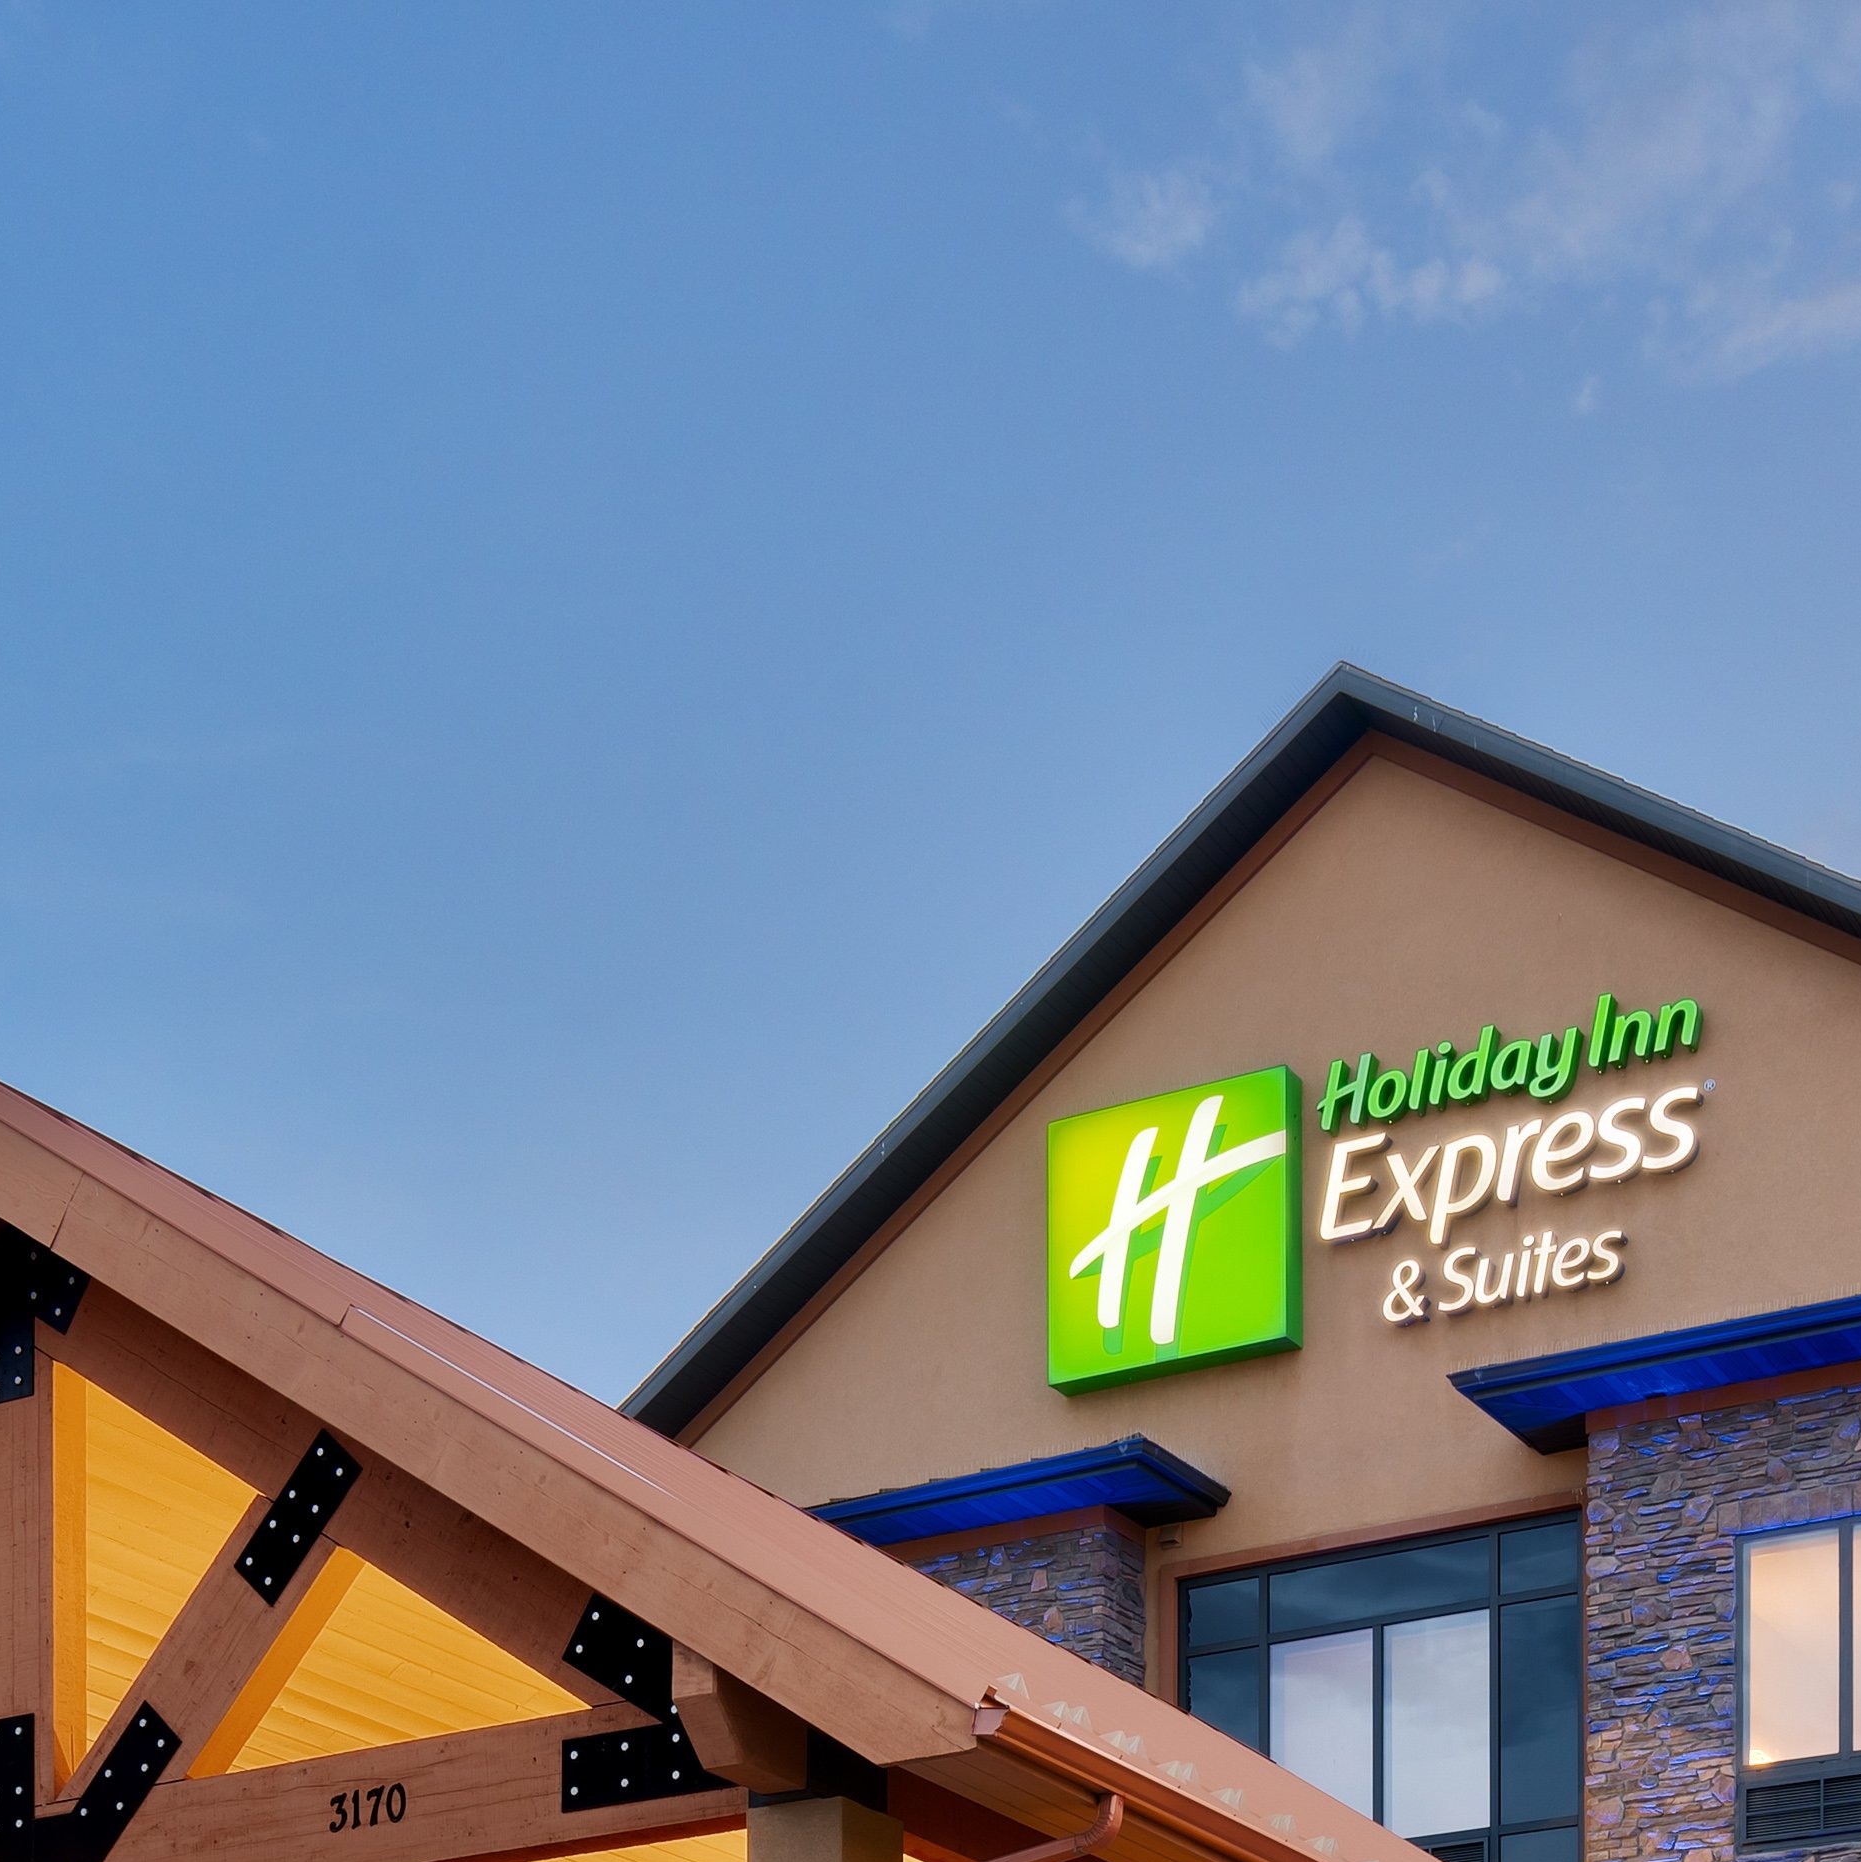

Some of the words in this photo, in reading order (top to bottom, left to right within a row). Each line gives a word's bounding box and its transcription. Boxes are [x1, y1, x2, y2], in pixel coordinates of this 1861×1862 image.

[1318, 1024, 1582, 1133] Holiday
[1588, 992, 1702, 1073] Inn
[1319, 1086, 1700, 1246] Express
[1381, 1259, 1426, 1325] &
[1438, 1230, 1625, 1313] Suites
[329, 1782, 406, 1833] 3170
